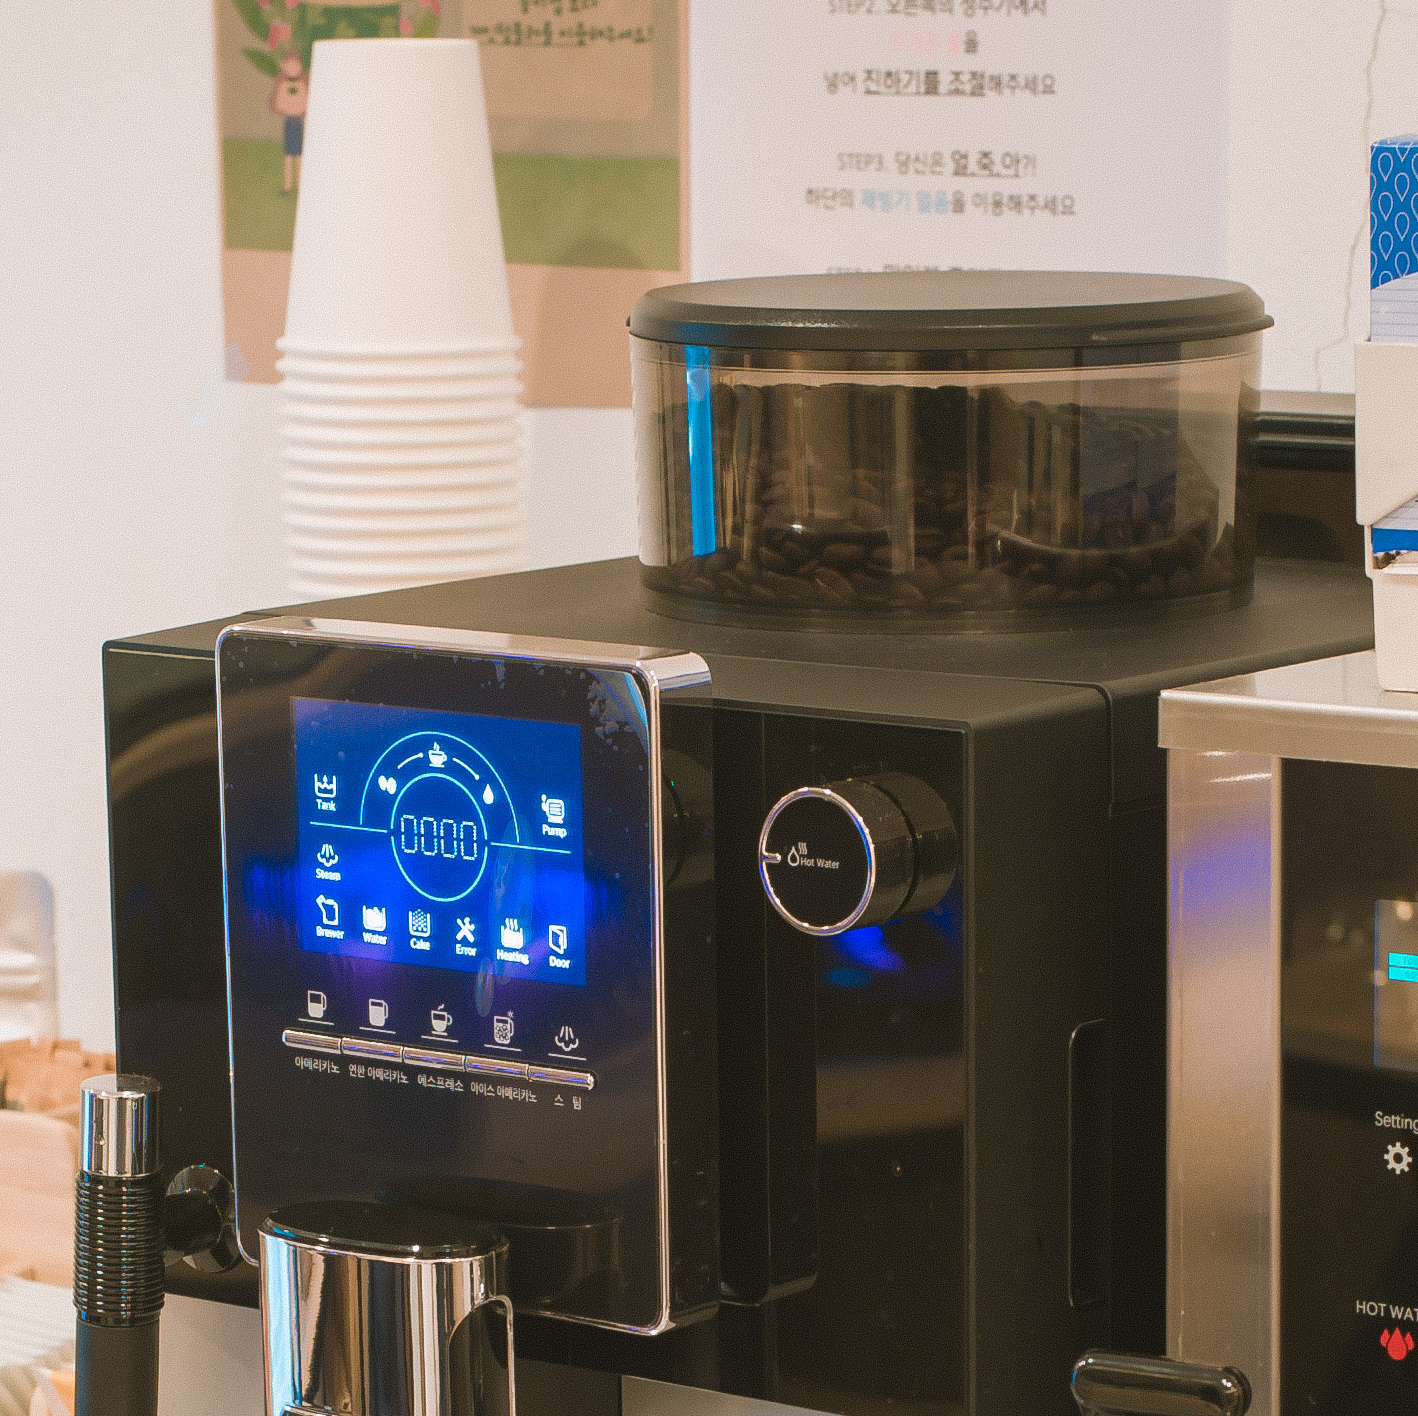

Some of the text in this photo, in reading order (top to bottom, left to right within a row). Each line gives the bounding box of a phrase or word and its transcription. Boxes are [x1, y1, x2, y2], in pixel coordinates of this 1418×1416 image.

[863, 69, 939, 96] 진하기를
[895, 150, 945, 175] 당신은
[805, 187, 855, 210] 하단의
[971, 191, 1077, 216] 이용해주세요
[315, 798, 336, 812] Tank
[399, 814, 478, 861] 0000
[541, 824, 568, 839] Pump
[800, 857, 840, 869] Hot Water
[362, 931, 388, 946] Water
[455, 943, 477, 957] Error
[496, 948, 530, 966] Heating
[548, 954, 571, 970] Door
[294, 1055, 341, 1074] 아메리카노
[367, 1066, 410, 1084] 아메리카노
[417, 1073, 464, 1093] 에스프레소
[470, 1079, 538, 1103] 아이스 아메리카노
[1356, 1300, 1387, 1318] HOT
